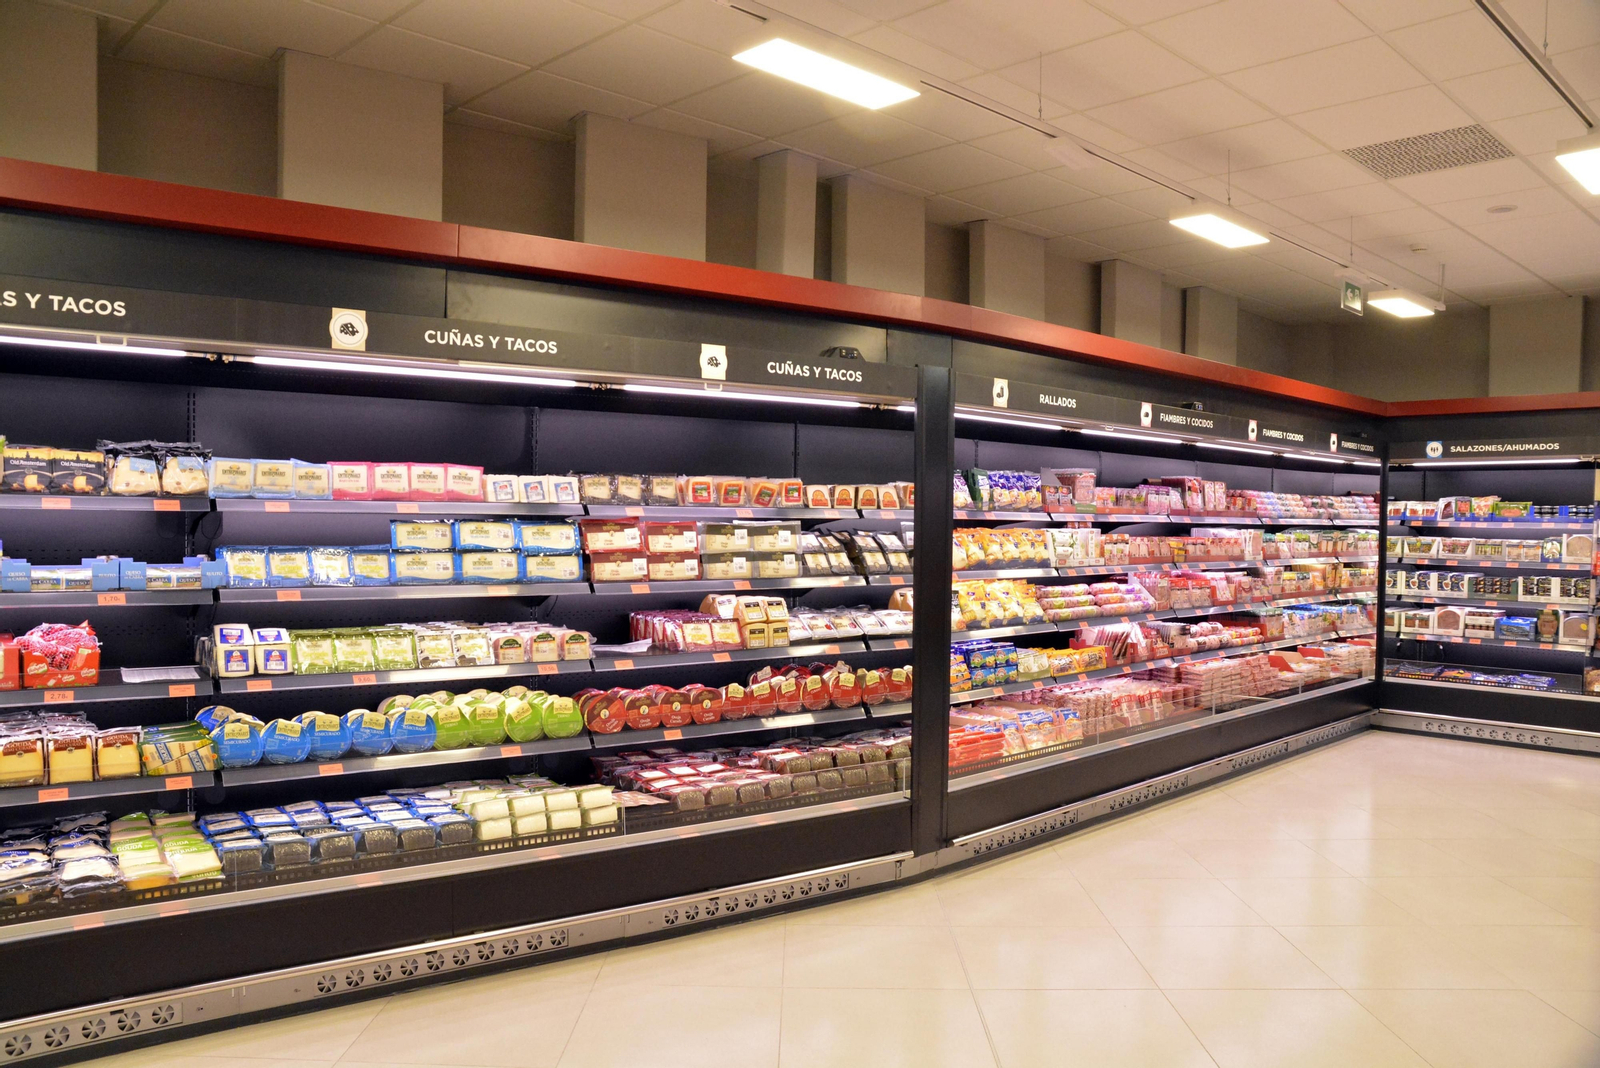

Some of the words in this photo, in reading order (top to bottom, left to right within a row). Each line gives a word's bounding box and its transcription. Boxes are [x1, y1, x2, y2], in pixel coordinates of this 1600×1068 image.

[0, 290, 17, 307] S
[24, 292, 41, 309] Y
[48, 295, 126, 316] TACOS
[424, 328, 484, 348] CUÑAS
[489, 336, 500, 349] Y
[505, 337, 558, 354] TACOS
[767, 361, 810, 377] CUÑAS
[813, 366, 821, 378] Y
[824, 368, 862, 382] TACOS
[1040, 394, 1077, 409] RALLADOS
[1160, 412, 1186, 425] FIAMBRES
[1191, 418, 1214, 429] COCIDOS
[1450, 443, 1560, 453] SALAZONES/AHUMADOS
[116, 842, 142, 852] GOUDA
